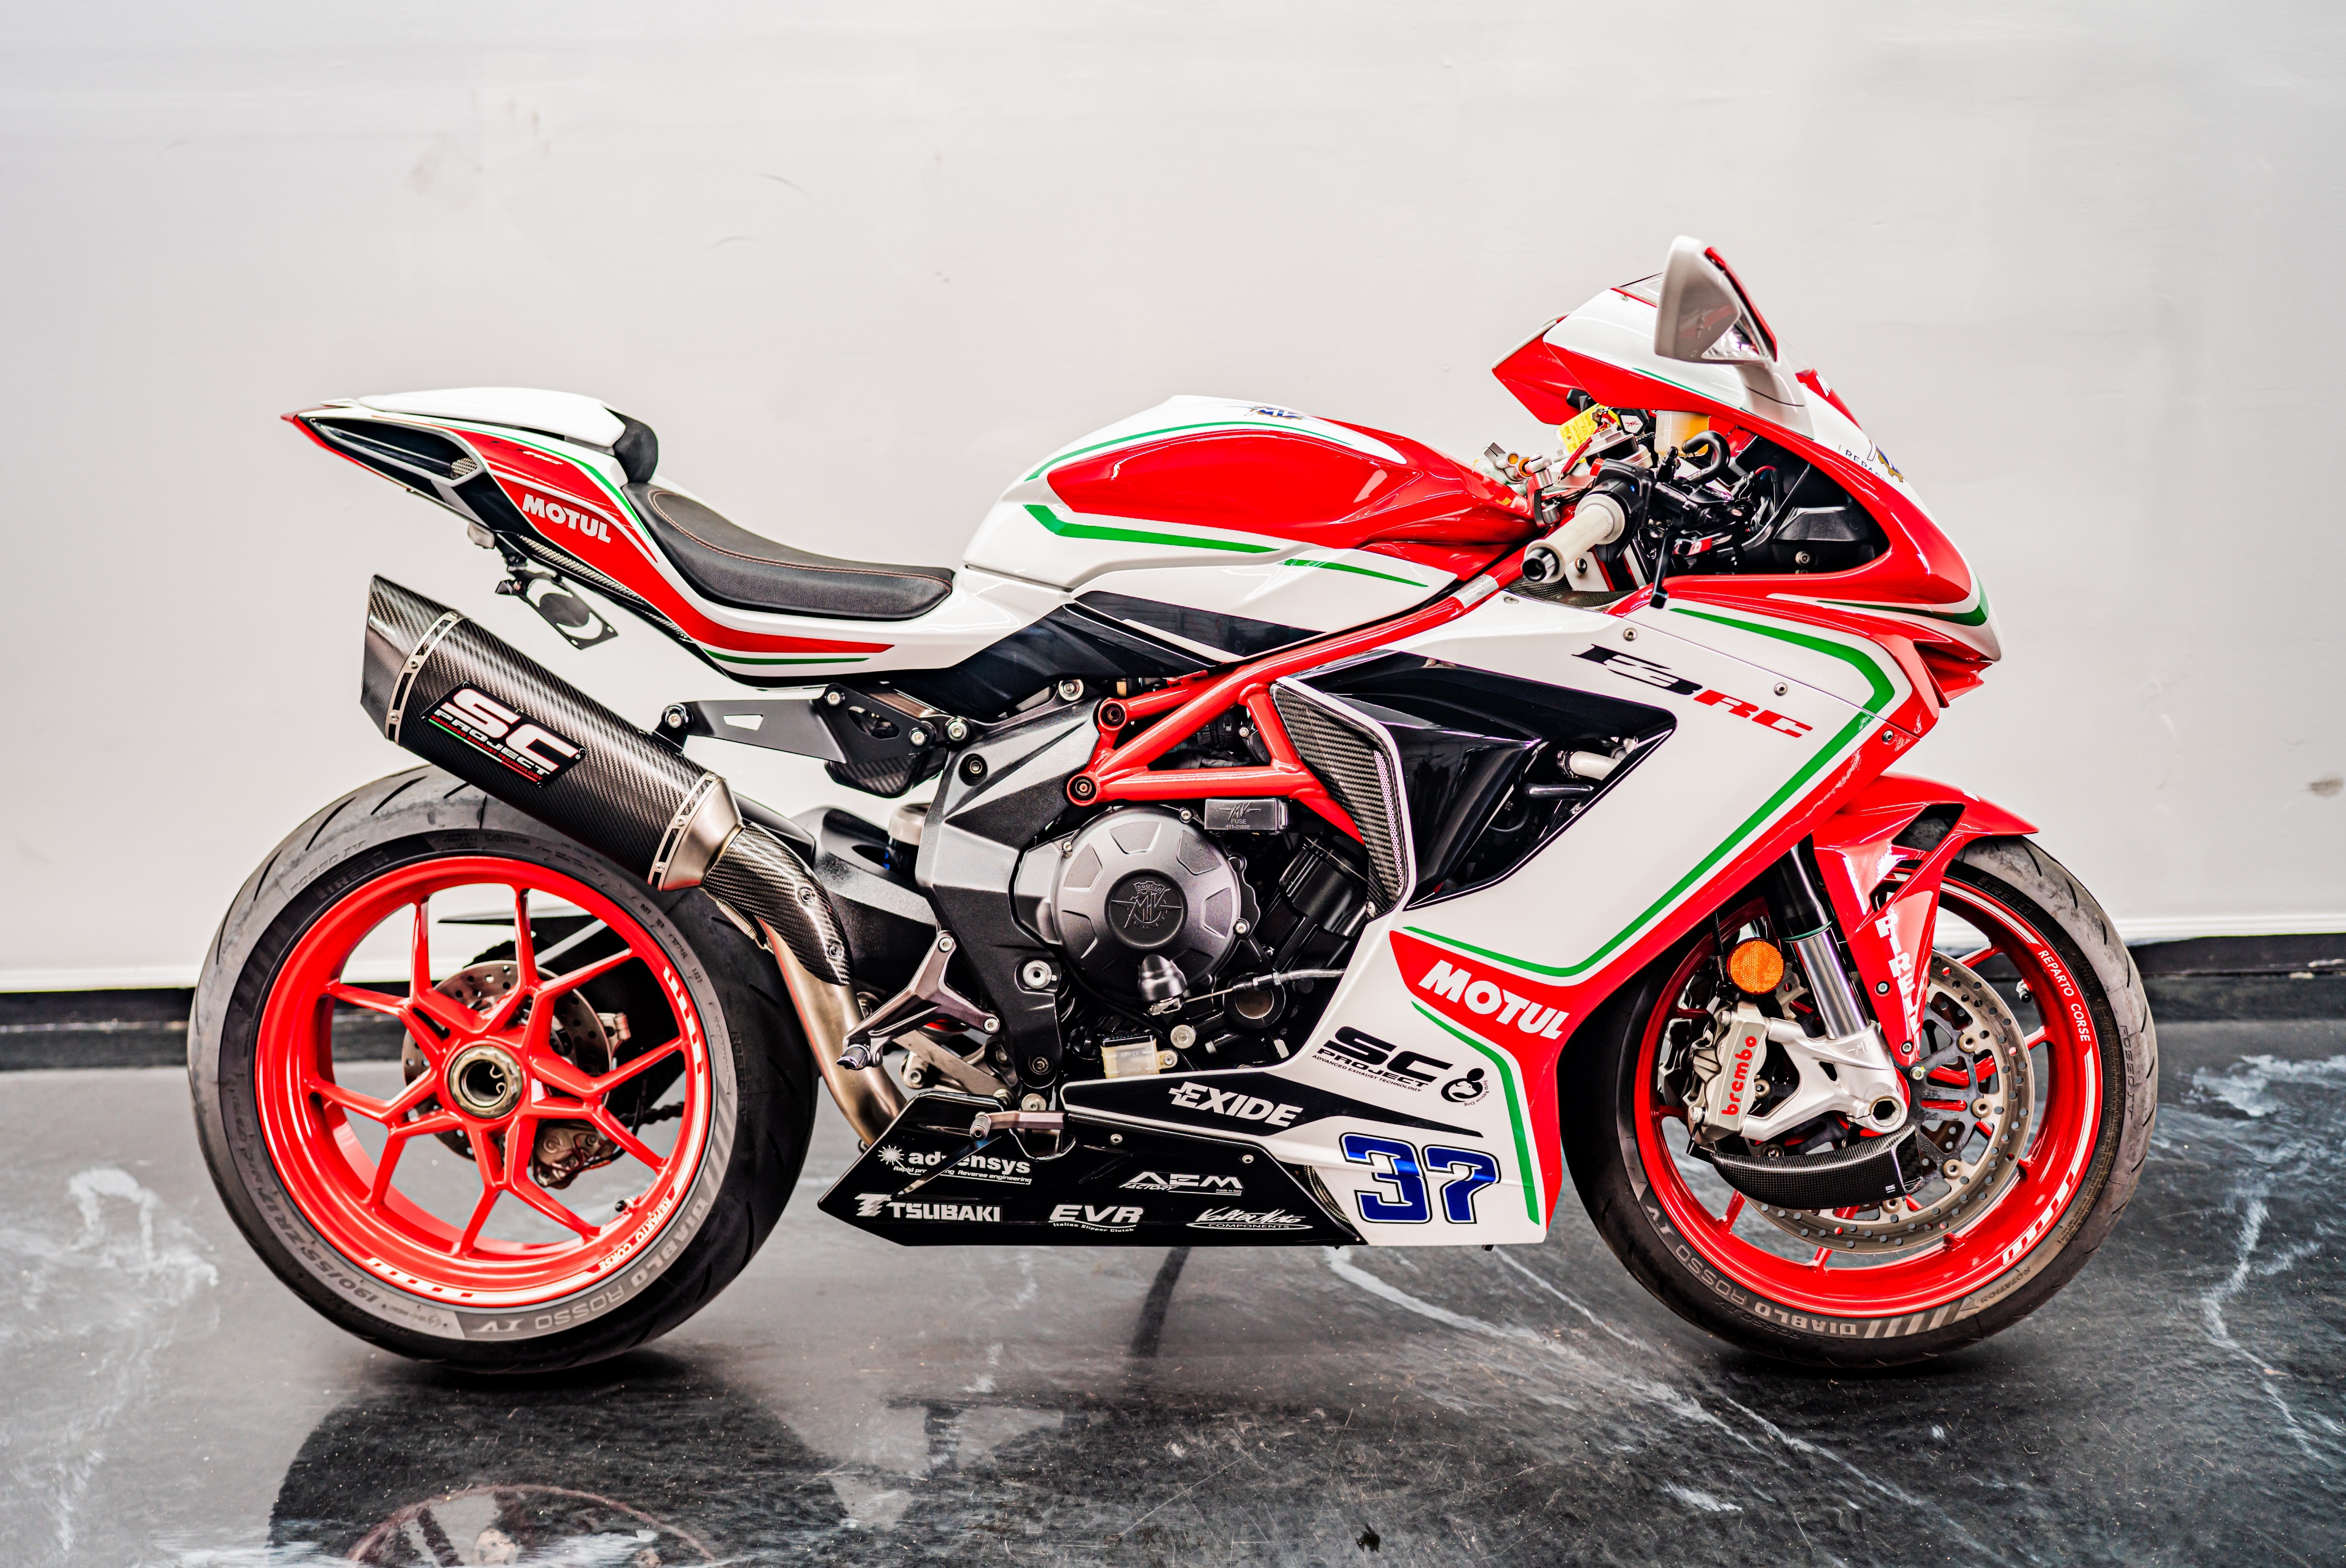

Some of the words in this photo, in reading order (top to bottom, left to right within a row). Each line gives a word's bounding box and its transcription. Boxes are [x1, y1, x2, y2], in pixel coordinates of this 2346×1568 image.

[522, 494, 611, 543] MOTUL
[440, 688, 579, 772] SC
[1693, 689, 1813, 738] RC
[430, 715, 466, 737] ADVANCED
[466, 736, 497, 755] EXHAUST
[498, 752, 543, 781] TECHNOLOGY
[434, 709, 550, 776] PROJECT
[1223, 802, 1256, 821] MV
[1118, 888, 1176, 928] MV
[1418, 959, 1569, 1040] MOTUL
[1874, 913, 1920, 1051] PIRELLI
[2038, 950, 2074, 997] REPARTO
[2071, 1004, 2091, 1042] CORSE
[1312, 1054, 1347, 1071] ADVANCED
[1347, 1067, 1379, 1081] EXHAUST
[1379, 1077, 1422, 1093] TECHNOLOGY
[1317, 1048, 1429, 1087] PROJECT
[1324, 1026, 1453, 1082] SC
[1721, 1036, 1757, 1116] brembo
[1169, 1081, 1303, 1127] EXIDE
[1476, 1091, 1489, 1102] Rescue
[893, 1166, 914, 1174] Rapid
[988, 1174, 1032, 1183] engineering
[1127, 1171, 1243, 1189] AEM
[1339, 1132, 1502, 1224] 37
[635, 1197, 673, 1243] REPARTO
[886, 1202, 1000, 1222] TSUBAKI
[1049, 1205, 1144, 1223] EVR
[1643, 1202, 1675, 1238] IV
[598, 1243, 633, 1272] CORSE
[630, 1197, 710, 1289] DIABLO
[303, 1246, 379, 1305] 190/55
[1675, 1244, 1747, 1305] ROSSO
[1980, 1266, 2031, 1304] ROTATION
[472, 1317, 525, 1334] IV
[535, 1288, 625, 1331] ROSSO
[1741, 1314, 1806, 1340] ROSSO
[1754, 1301, 1857, 1336] DIABLO
